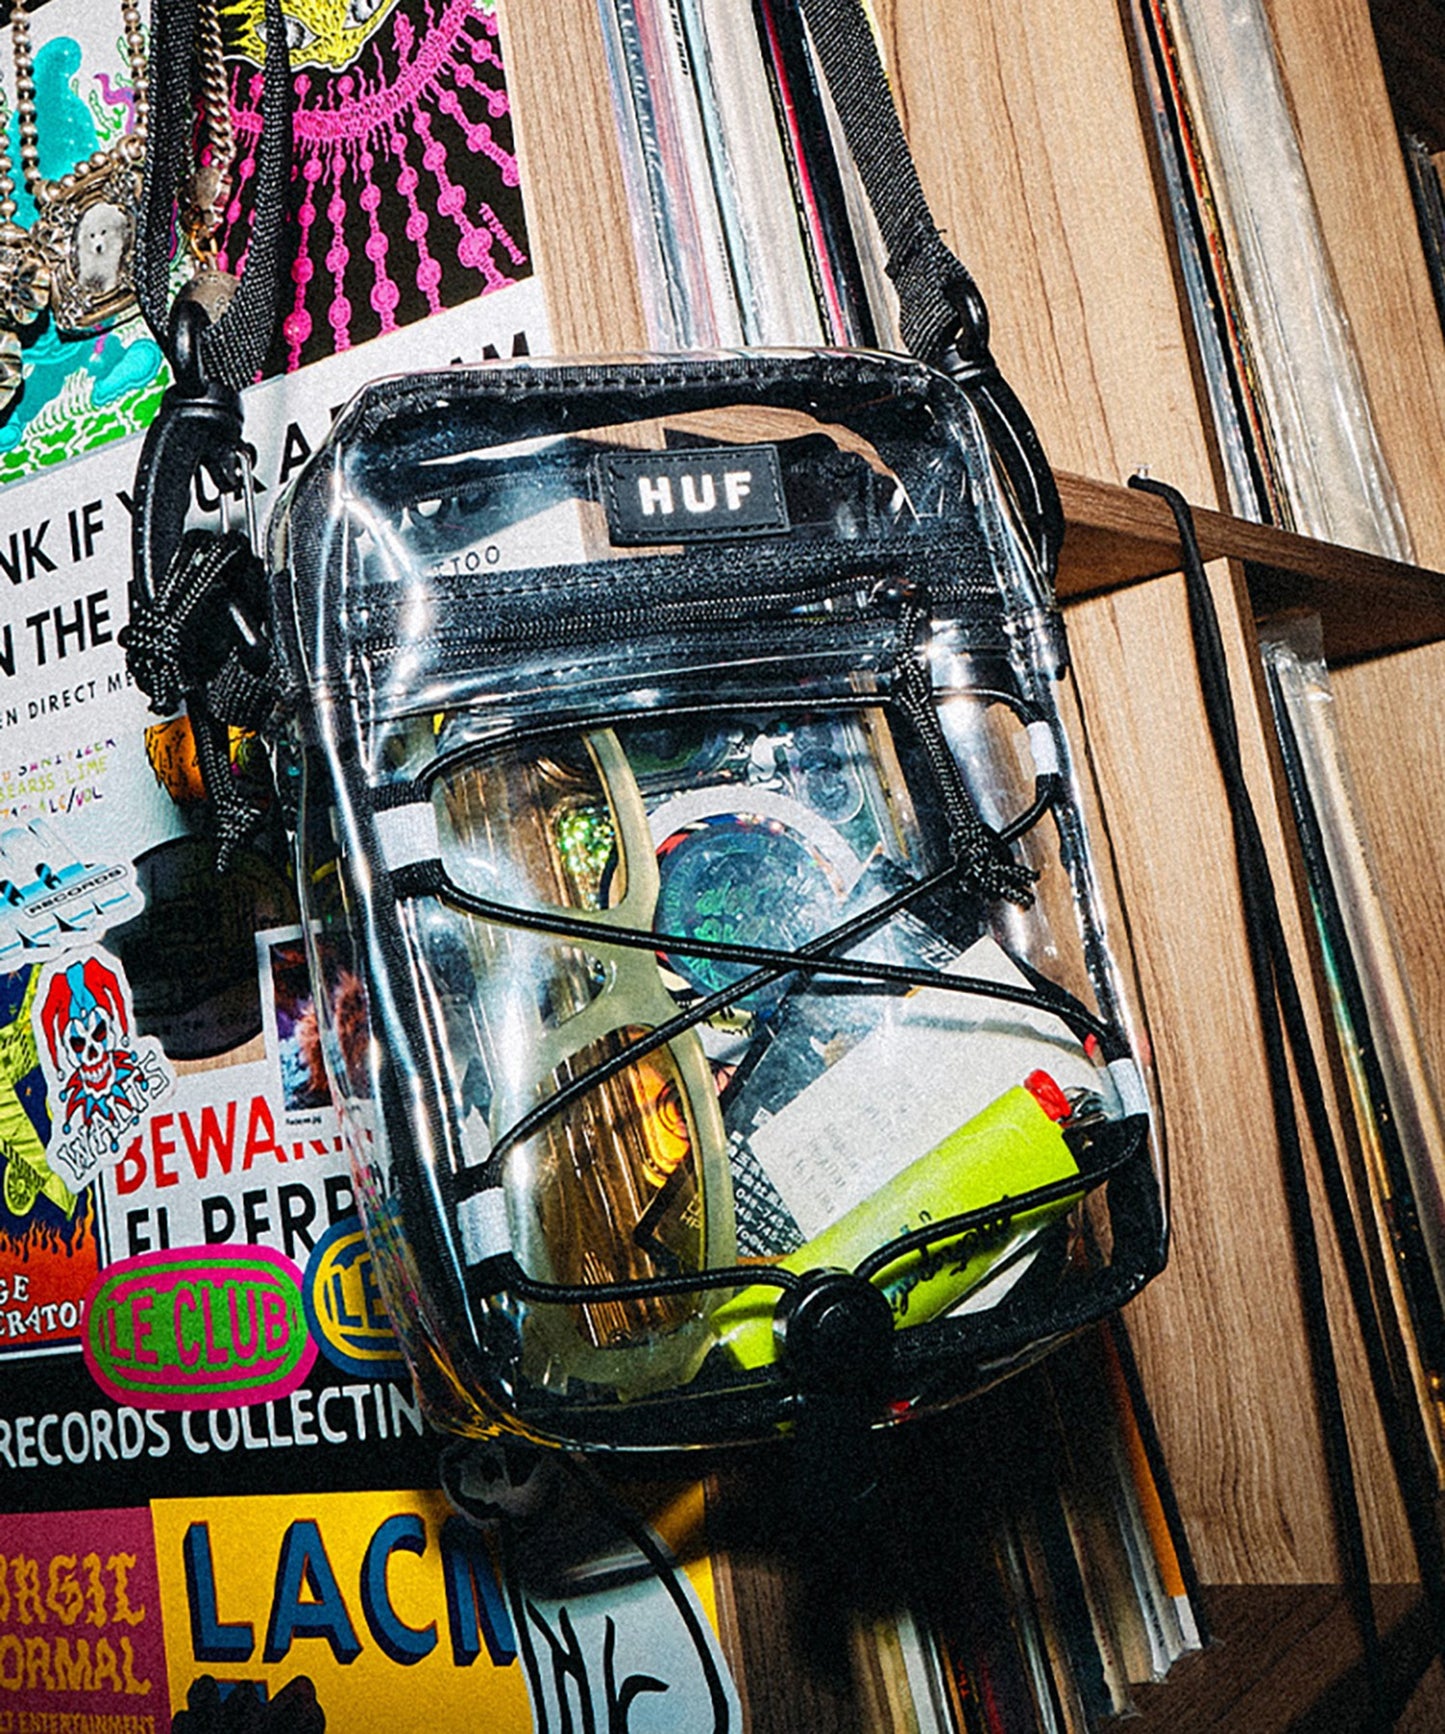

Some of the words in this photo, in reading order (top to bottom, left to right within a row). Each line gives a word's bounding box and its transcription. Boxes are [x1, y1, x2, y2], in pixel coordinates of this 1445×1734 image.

[638, 470, 752, 515] HUF
[68, 499, 104, 563] IF
[26, 588, 113, 666] THE
[28, 680, 96, 719] DIRECT
[114, 1095, 346, 1196] BEWA
[0, 1299, 85, 1338] RATO
[105, 1295, 160, 1365] LE
[173, 1283, 292, 1368] CLUB
